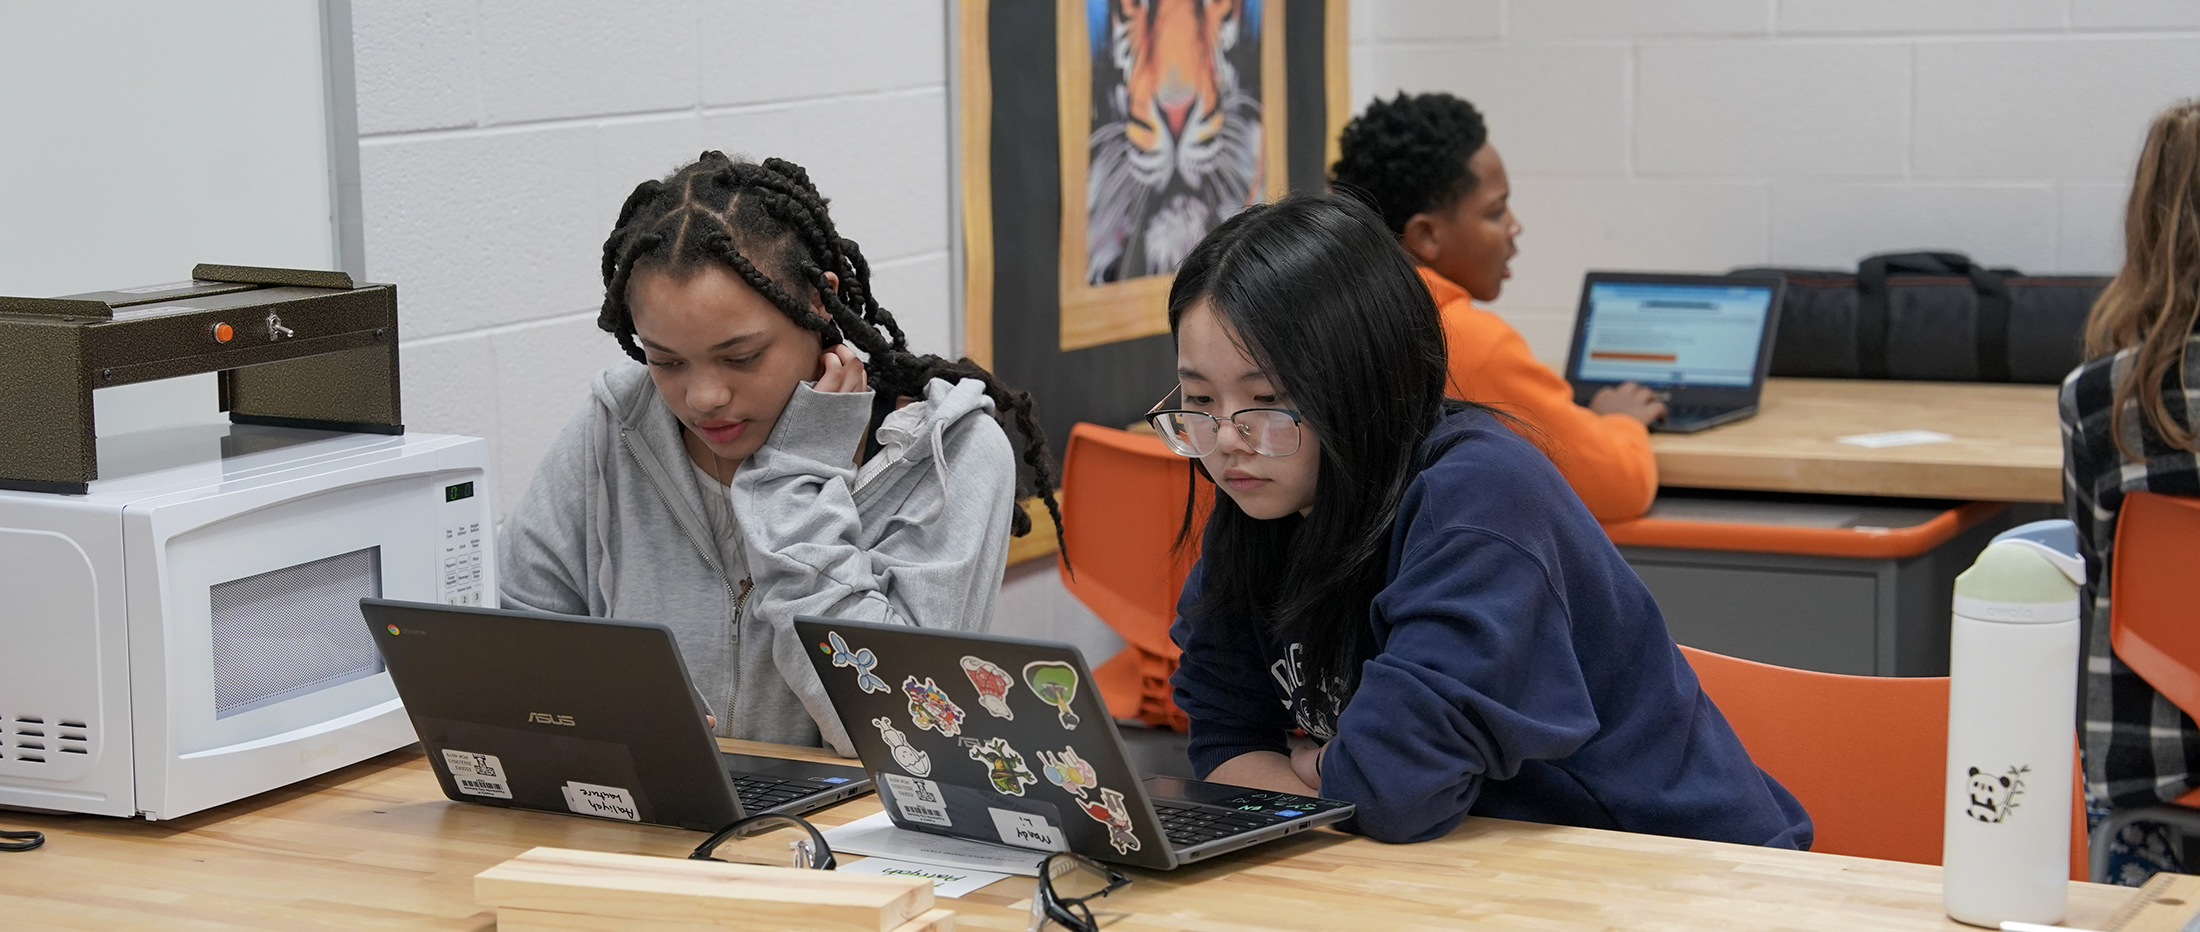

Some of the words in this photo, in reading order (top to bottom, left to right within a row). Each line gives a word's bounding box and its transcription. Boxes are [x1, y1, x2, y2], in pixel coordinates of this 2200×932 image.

[528, 712, 576, 726] ASUS
[588, 799, 634, 819] Aaliyah
[1019, 816, 1033, 827] Li
